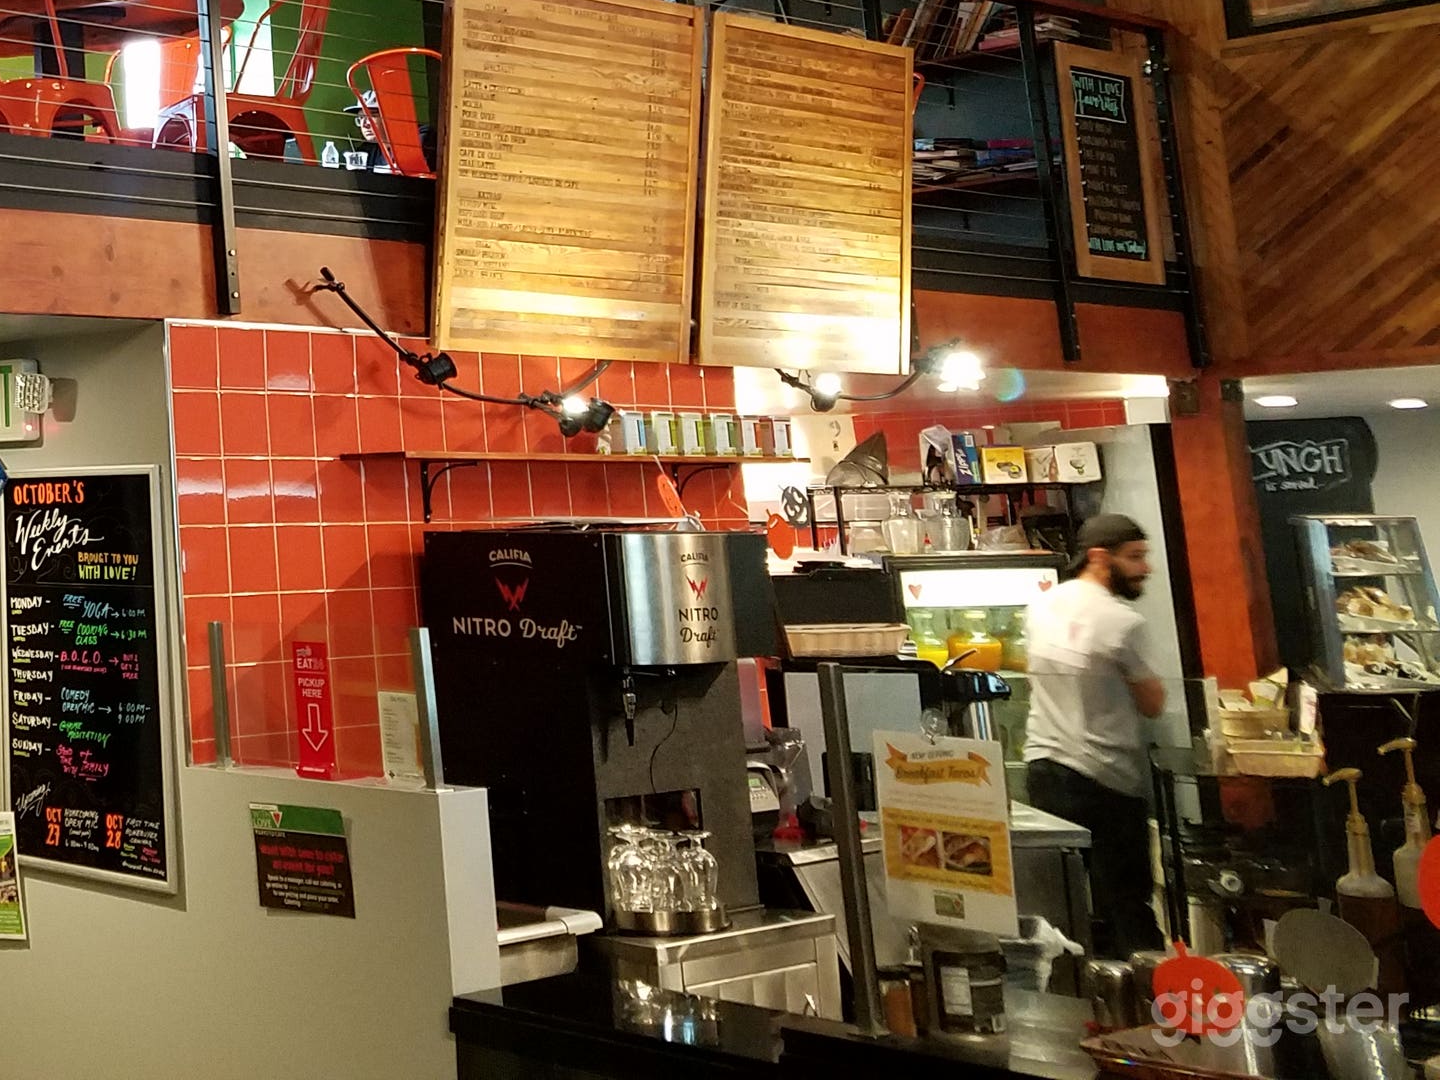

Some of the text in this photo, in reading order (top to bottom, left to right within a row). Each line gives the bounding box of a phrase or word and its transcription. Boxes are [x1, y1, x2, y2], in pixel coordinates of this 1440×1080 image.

[13, 480, 85, 506] OCTOBER'S
[15, 508, 82, 555] Weekly
[31, 524, 105, 571] Events
[488, 548, 532, 564] CALIFIA
[111, 553, 120, 565] TO
[122, 554, 140, 565] YOU
[78, 565, 137, 580] WITH LOVE!
[10, 596, 43, 611] MONDAY
[63, 593, 85, 604] FREE
[81, 600, 114, 619] YOGA
[678, 607, 719, 622] NITRO
[10, 622, 49, 637] TUESDAY
[453, 616, 511, 638] NITRO
[11, 668, 54, 682] THURSDAY
[298, 677, 326, 688] PICKUP
[13, 687, 90, 705] FRIDAY COMEDY
[302, 688, 323, 699] HERE
[12, 711, 52, 729] SATURDAY
[12, 738, 43, 755] SUNDAY
[46, 807, 63, 823] OCT
[106, 813, 124, 830] OCT
[106, 830, 122, 850] 28
